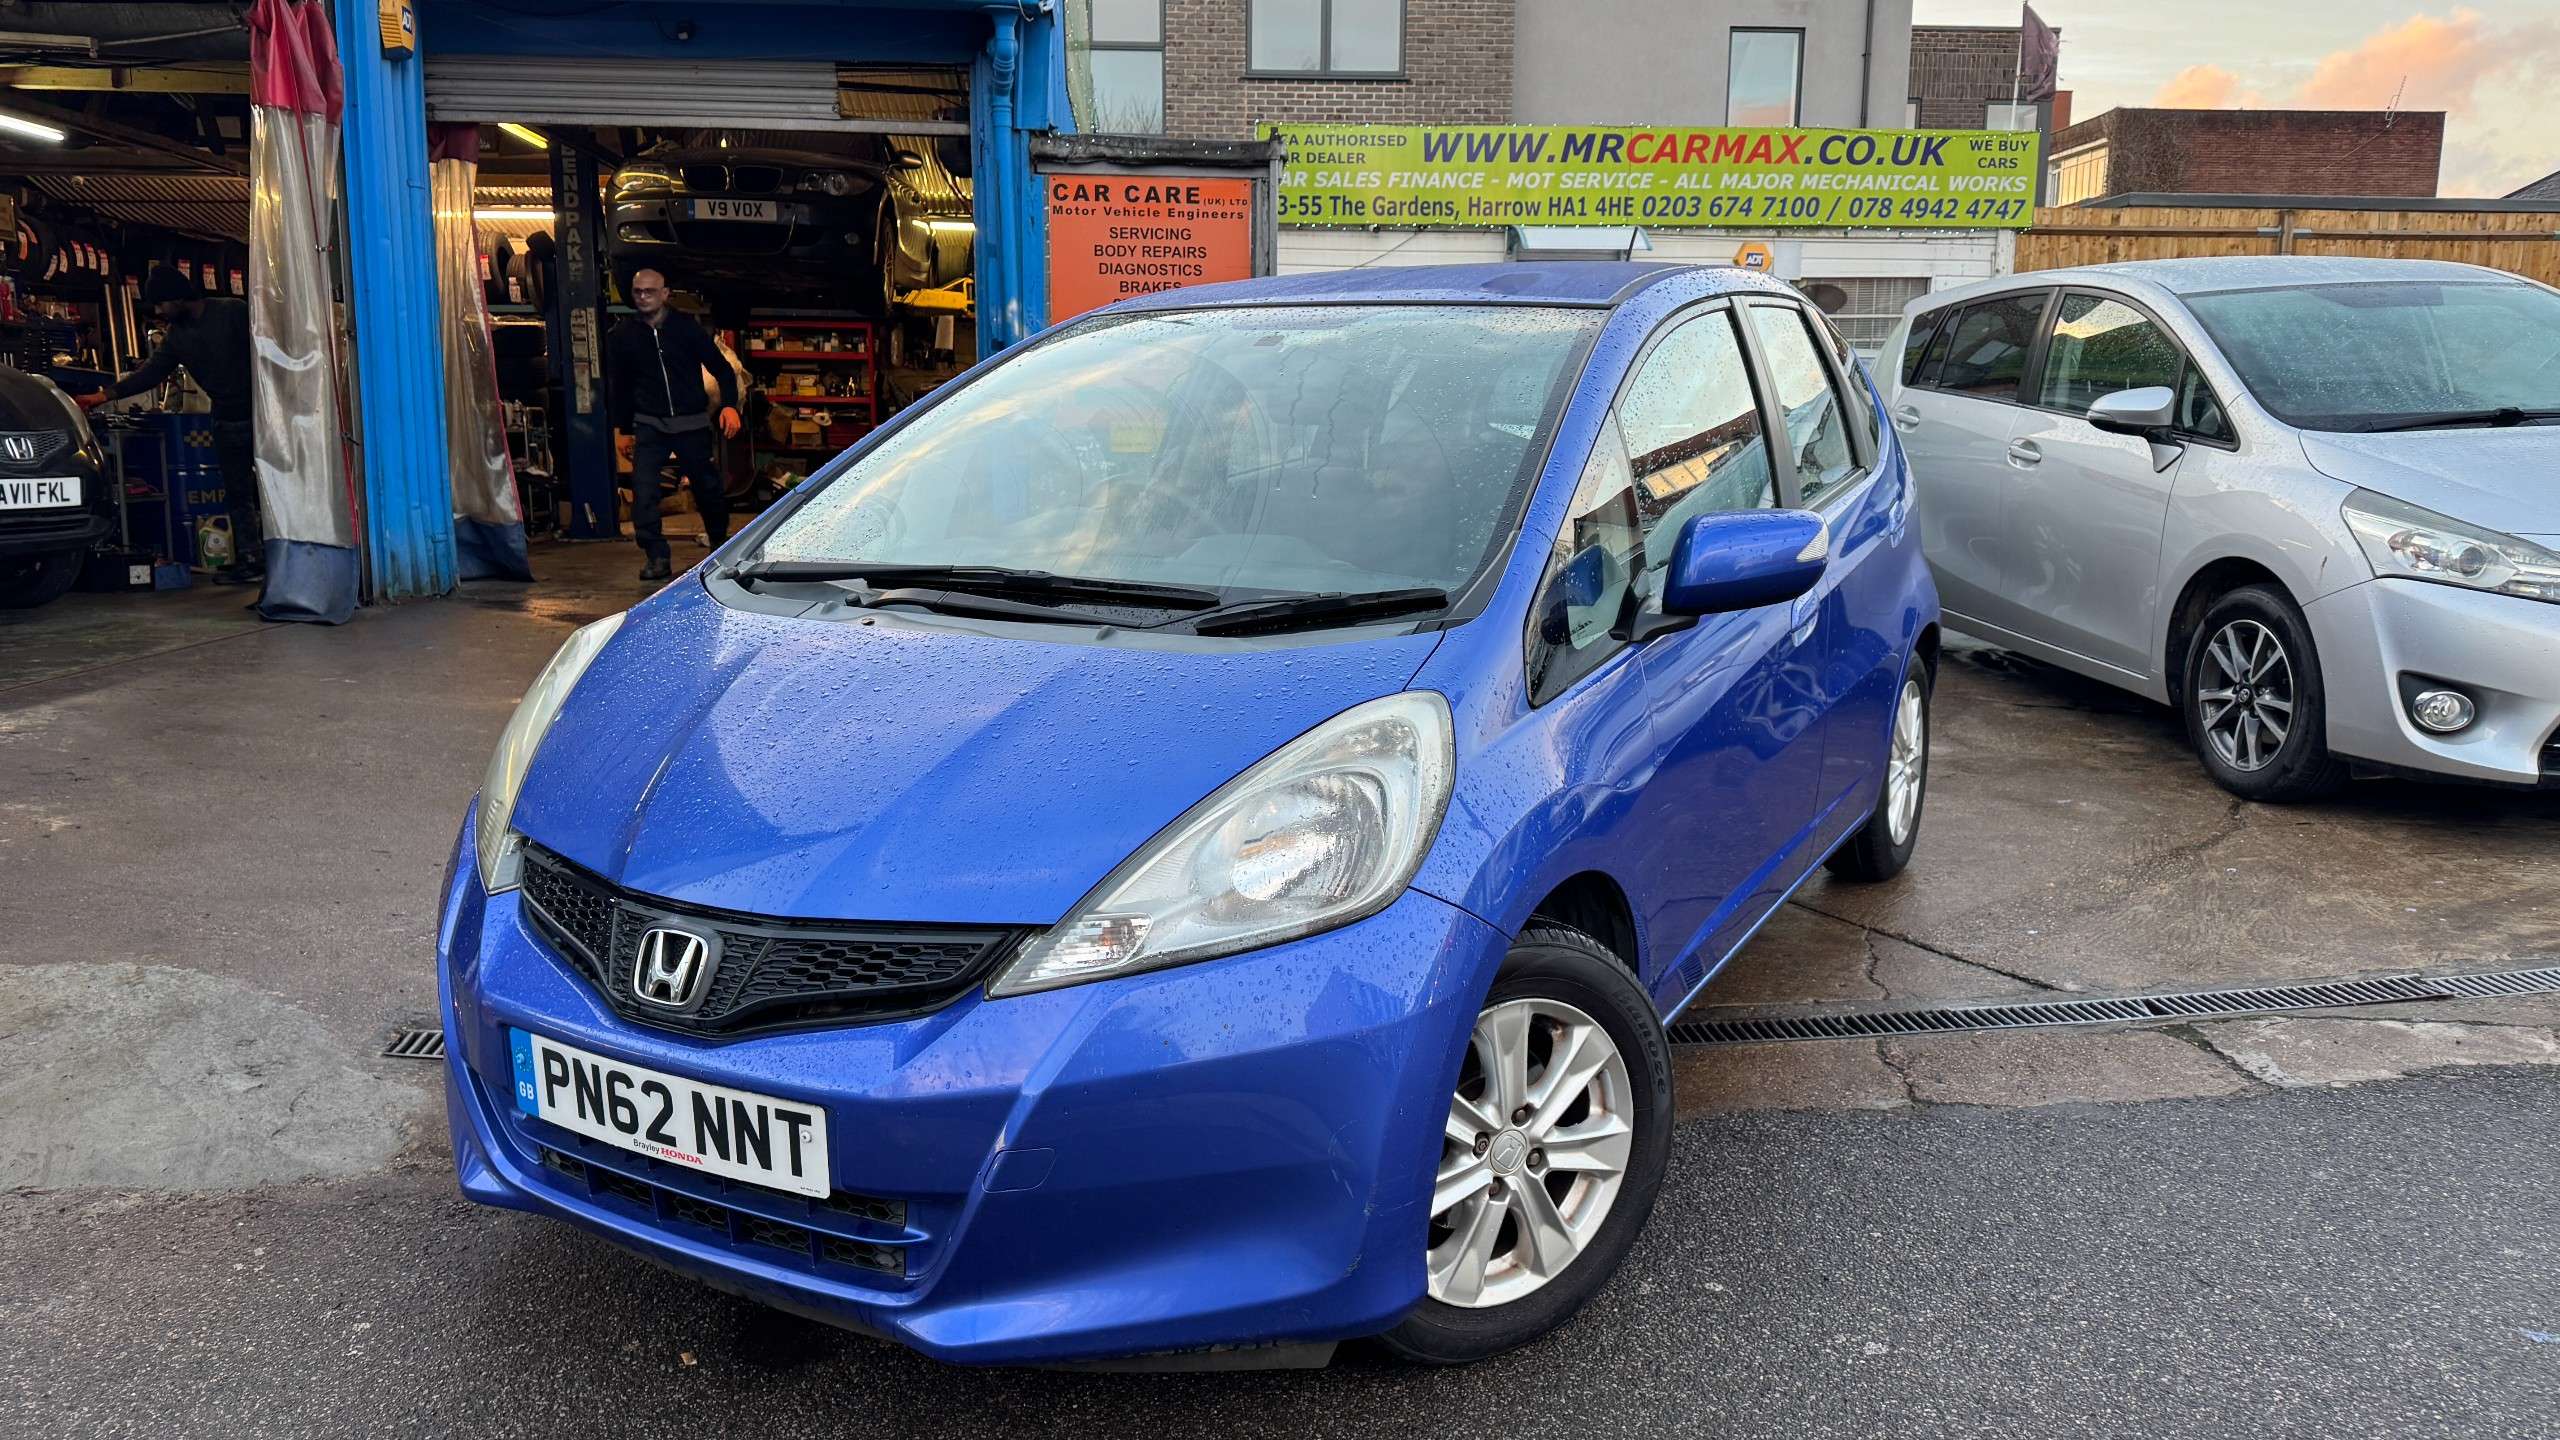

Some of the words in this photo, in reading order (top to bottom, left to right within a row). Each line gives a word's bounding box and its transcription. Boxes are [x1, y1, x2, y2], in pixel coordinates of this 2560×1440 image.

[1304, 134, 1407, 147] AUTHORISED
[1969, 139, 1994, 151] WE
[1998, 140, 2030, 152] BUY
[1423, 132, 1953, 167] WWW.MRCARMAX.CO.UK
[1307, 152, 1366, 164] DEALER
[1977, 157, 2018, 169] CARS
[1280, 171, 1308, 188] AR
[1313, 171, 1382, 188] SALES
[1387, 171, 1485, 189] FINANCE
[1506, 172, 1556, 189] MOT
[1559, 172, 1654, 189] SERVICE
[1674, 172, 1713, 189] ALL
[1720, 172, 1794, 190] MAJOR
[1800, 174, 1940, 192] MECHANICAL
[1949, 175, 2028, 192] WORKS
[1052, 183, 1110, 202] CAR
[1124, 185, 1201, 205] CARE
[1203, 197, 1226, 206] (UK)
[1230, 198, 1248, 206] LTD
[707, 201, 728, 216] V9
[732, 202, 764, 217] VOX
[1052, 206, 1097, 216] Motor
[1103, 206, 1161, 218] Vehicle
[1167, 208, 1244, 220] Engineers
[1278, 195, 1322, 216] 3-55
[1329, 195, 1366, 216] The
[1372, 195, 1460, 220] Gardens,
[1468, 196, 1542, 217] Harrow
[1549, 196, 1587, 217] HA1
[1595, 196, 1634, 217] 4HE
[1642, 196, 1701, 217] 0203
[1709, 196, 1753, 217] 674
[1760, 196, 1820, 217] 7100
[1825, 196, 1842, 222] /
[1848, 197, 1893, 218] 078
[1900, 198, 1960, 219] 4942
[1966, 199, 2026, 220] 4747
[1109, 227, 1192, 240] SERVICING
[1094, 245, 1137, 257] BODY
[1142, 246, 1207, 259] REPAIRS
[1099, 262, 1203, 276] DIAGNOSTICS
[37, 482, 70, 503] FKL
[519, 1080, 535, 1100] GB
[541, 1046, 677, 1147] PN62
[691, 1090, 812, 1178] NNT
[633, 1138, 660, 1154] Brayley
[661, 1147, 704, 1165] HONDA
